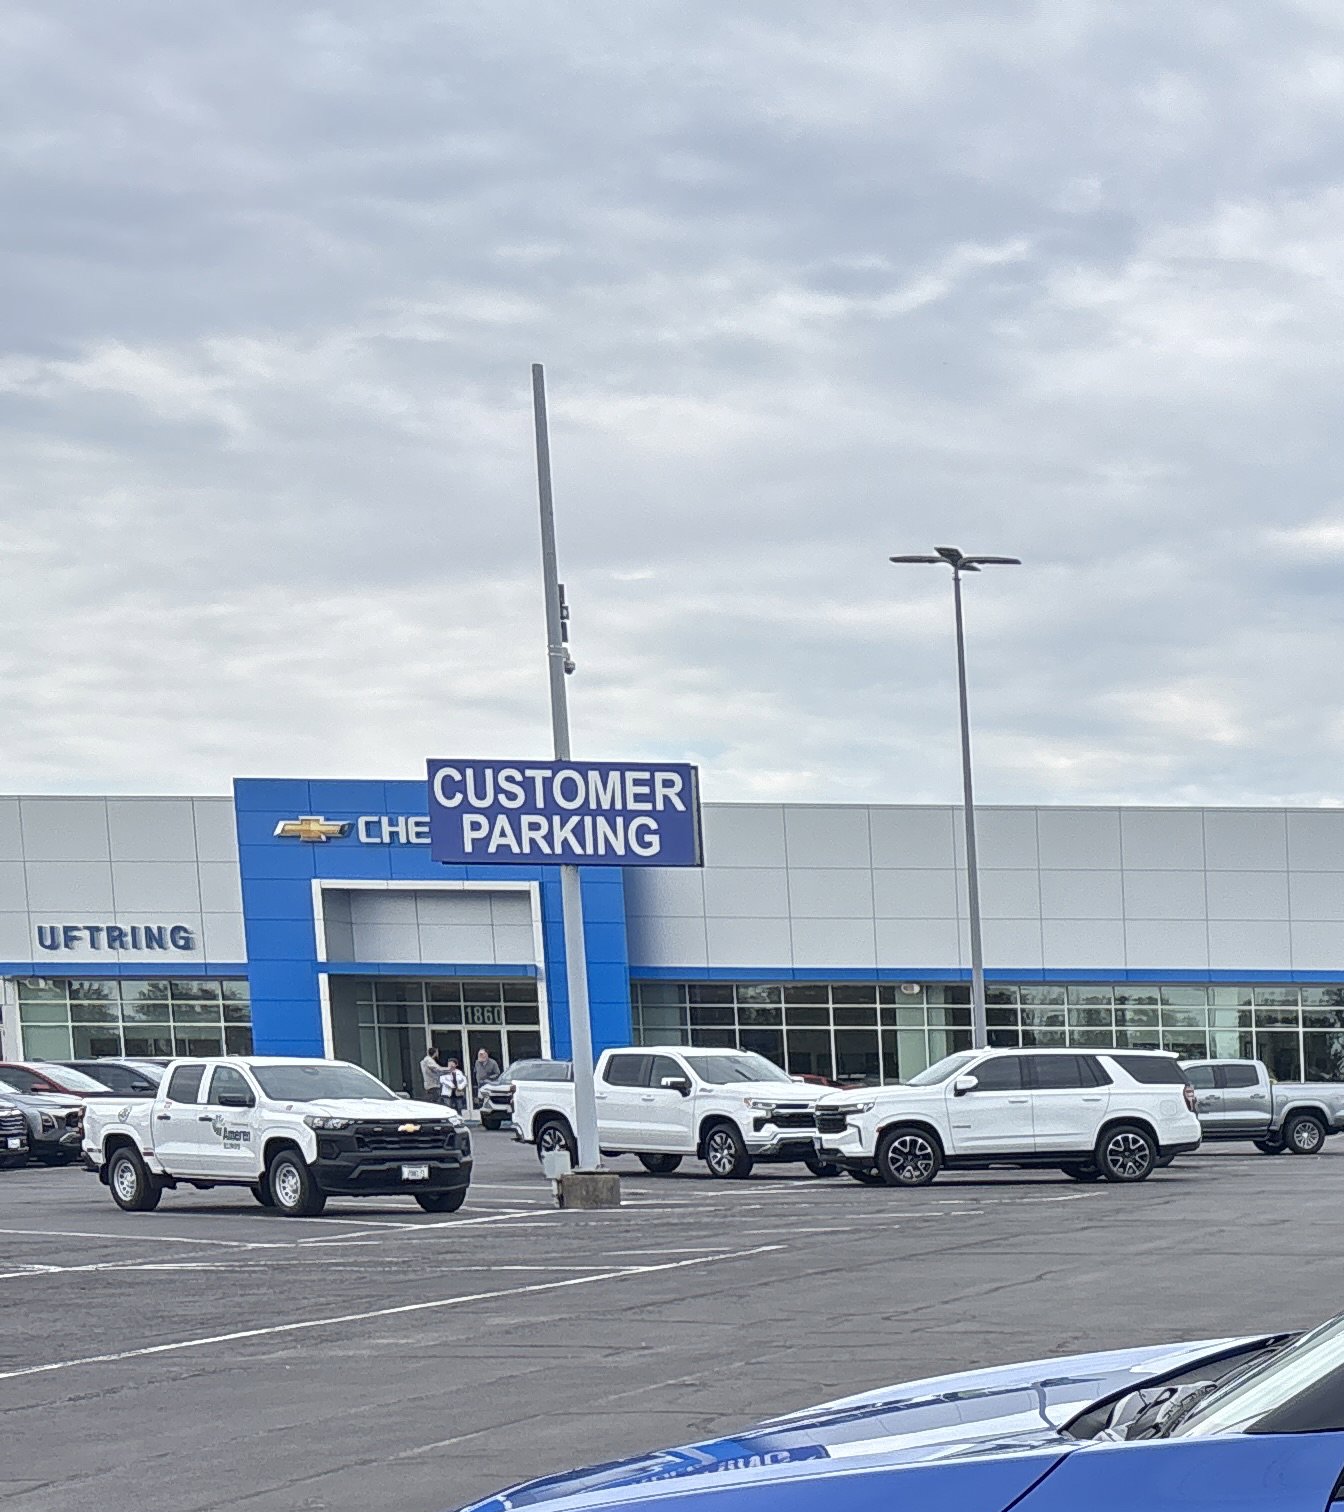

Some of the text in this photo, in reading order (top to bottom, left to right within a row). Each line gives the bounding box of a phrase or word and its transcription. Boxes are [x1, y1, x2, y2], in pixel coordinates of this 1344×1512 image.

[433, 767, 687, 812] CUSTOMER
[462, 813, 661, 857] PARKING
[37, 925, 196, 951] UFTRING
[465, 1006, 502, 1024] 1860
